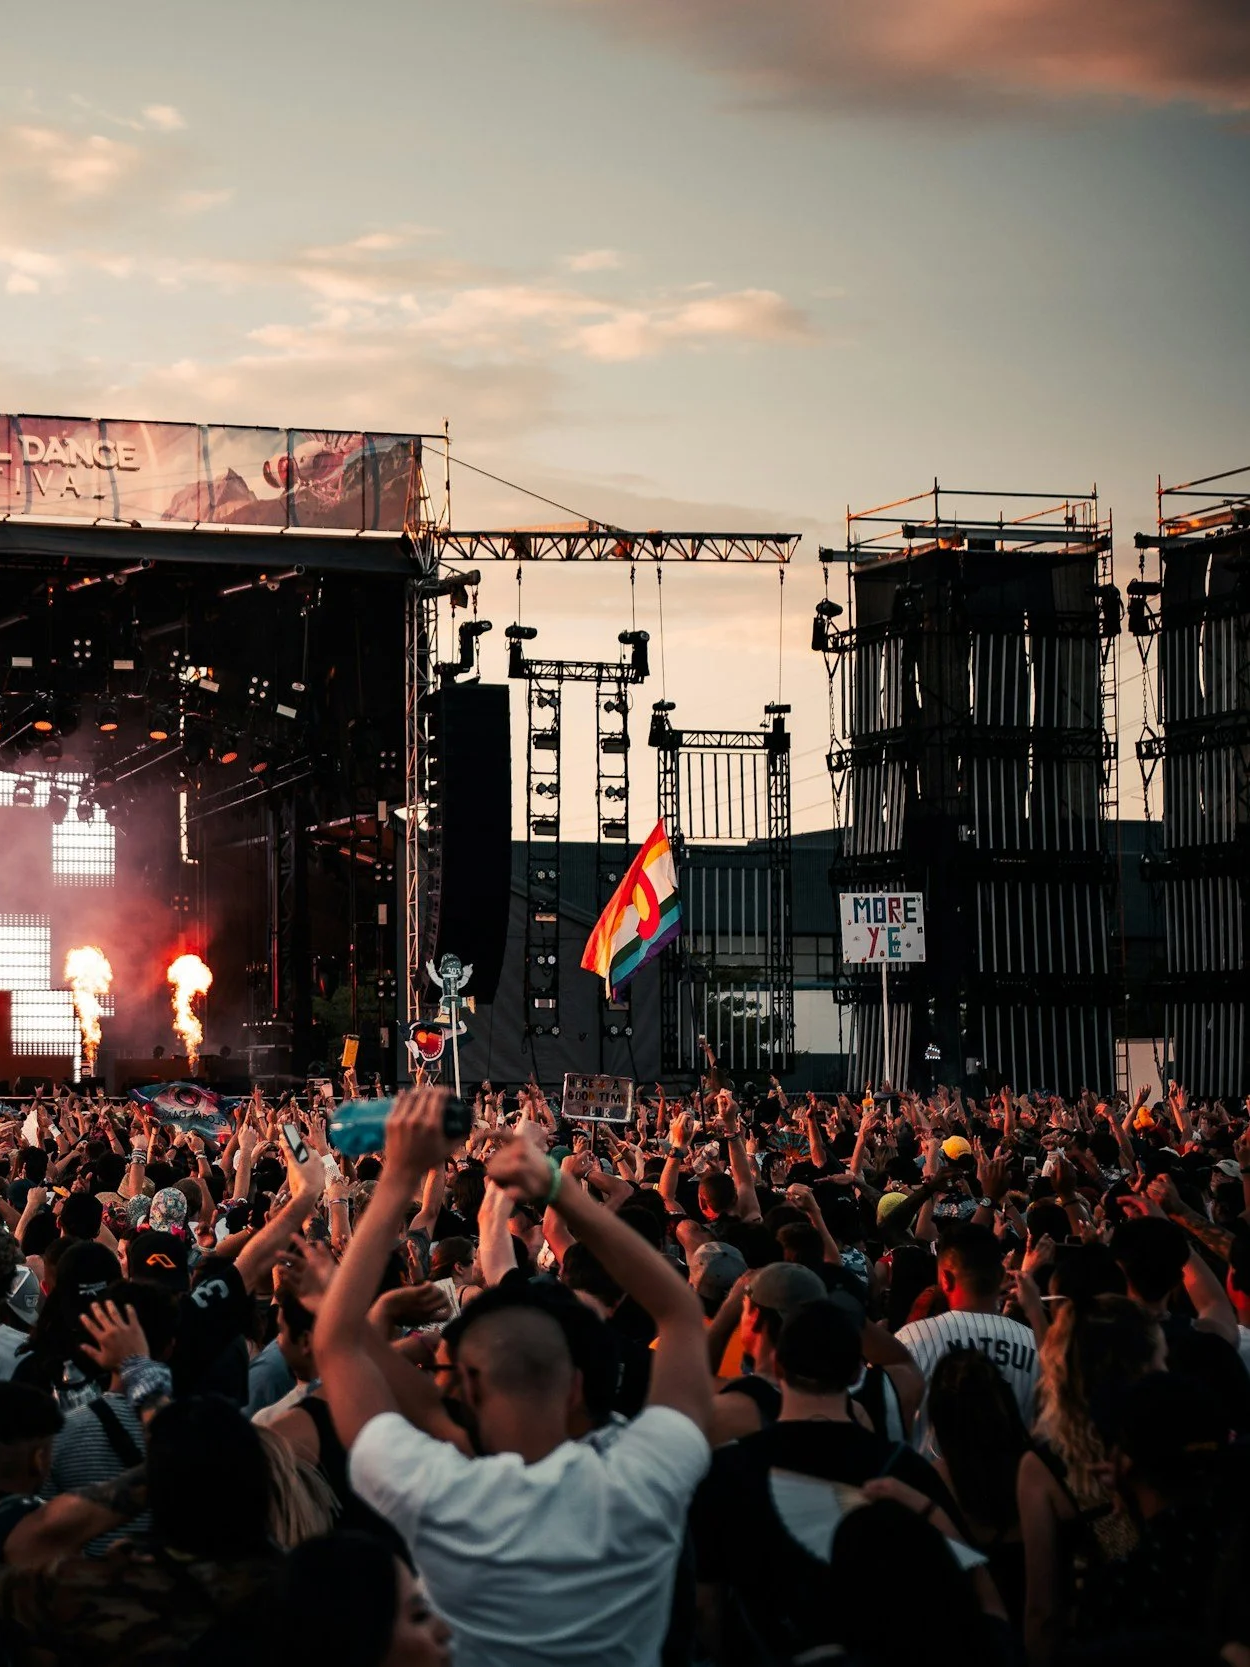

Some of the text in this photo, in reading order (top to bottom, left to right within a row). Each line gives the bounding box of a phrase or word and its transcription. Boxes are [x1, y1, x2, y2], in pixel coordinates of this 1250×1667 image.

[20, 434, 141, 471] DANCE
[853, 897, 917, 924] MORE
[867, 927, 902, 958] YE
[568, 1076, 594, 1089] HERE
[612, 1080, 620, 1090] A
